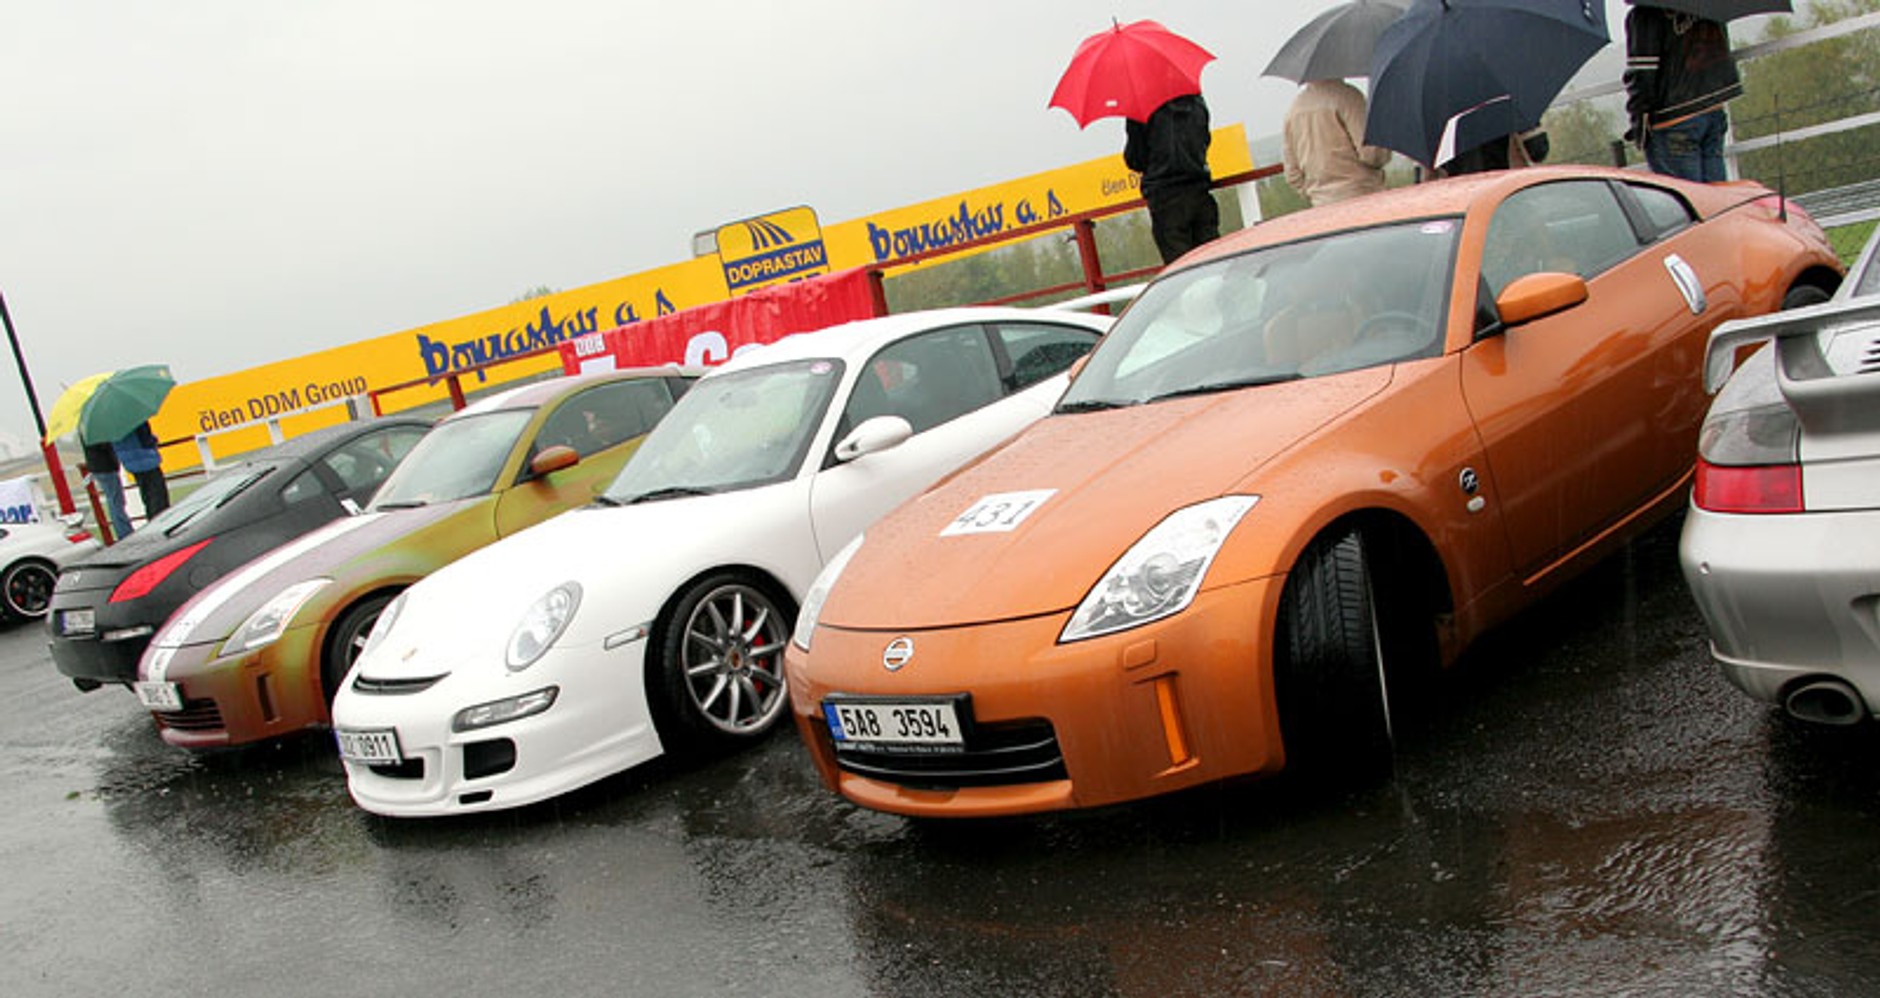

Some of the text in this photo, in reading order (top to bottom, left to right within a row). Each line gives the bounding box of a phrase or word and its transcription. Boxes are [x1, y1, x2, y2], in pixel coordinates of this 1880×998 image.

[728, 245, 822, 284] DOPRASTAV
[198, 375, 368, 433] člen DDM Group
[958, 500, 1036, 529] 431
[840, 708, 949, 738] 5A8 3594
